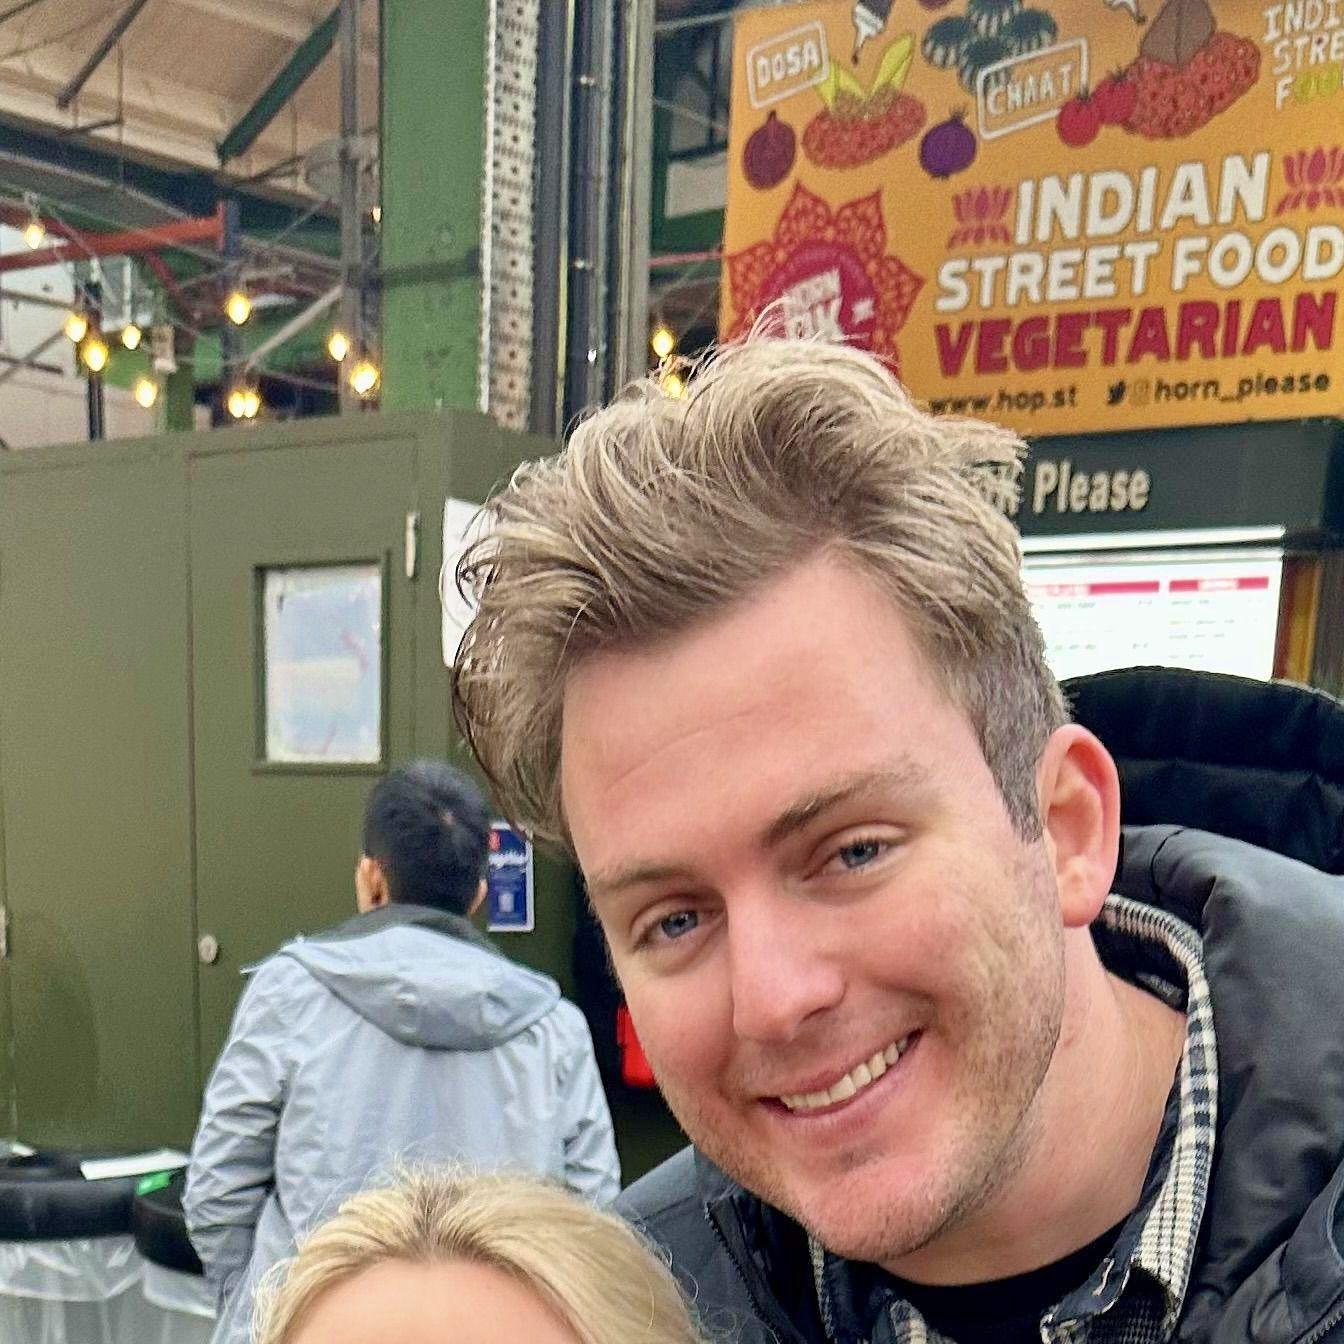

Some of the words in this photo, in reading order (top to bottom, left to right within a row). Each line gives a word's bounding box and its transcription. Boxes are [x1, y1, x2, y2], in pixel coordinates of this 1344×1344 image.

[756, 38, 820, 87] DOSA
[987, 61, 1075, 115] CHAAT
[1014, 152, 1271, 245] INDIAN
[934, 240, 1160, 312] STREET
[934, 291, 1338, 377] VEGETARIAN
[1032, 459, 1152, 514] Please
